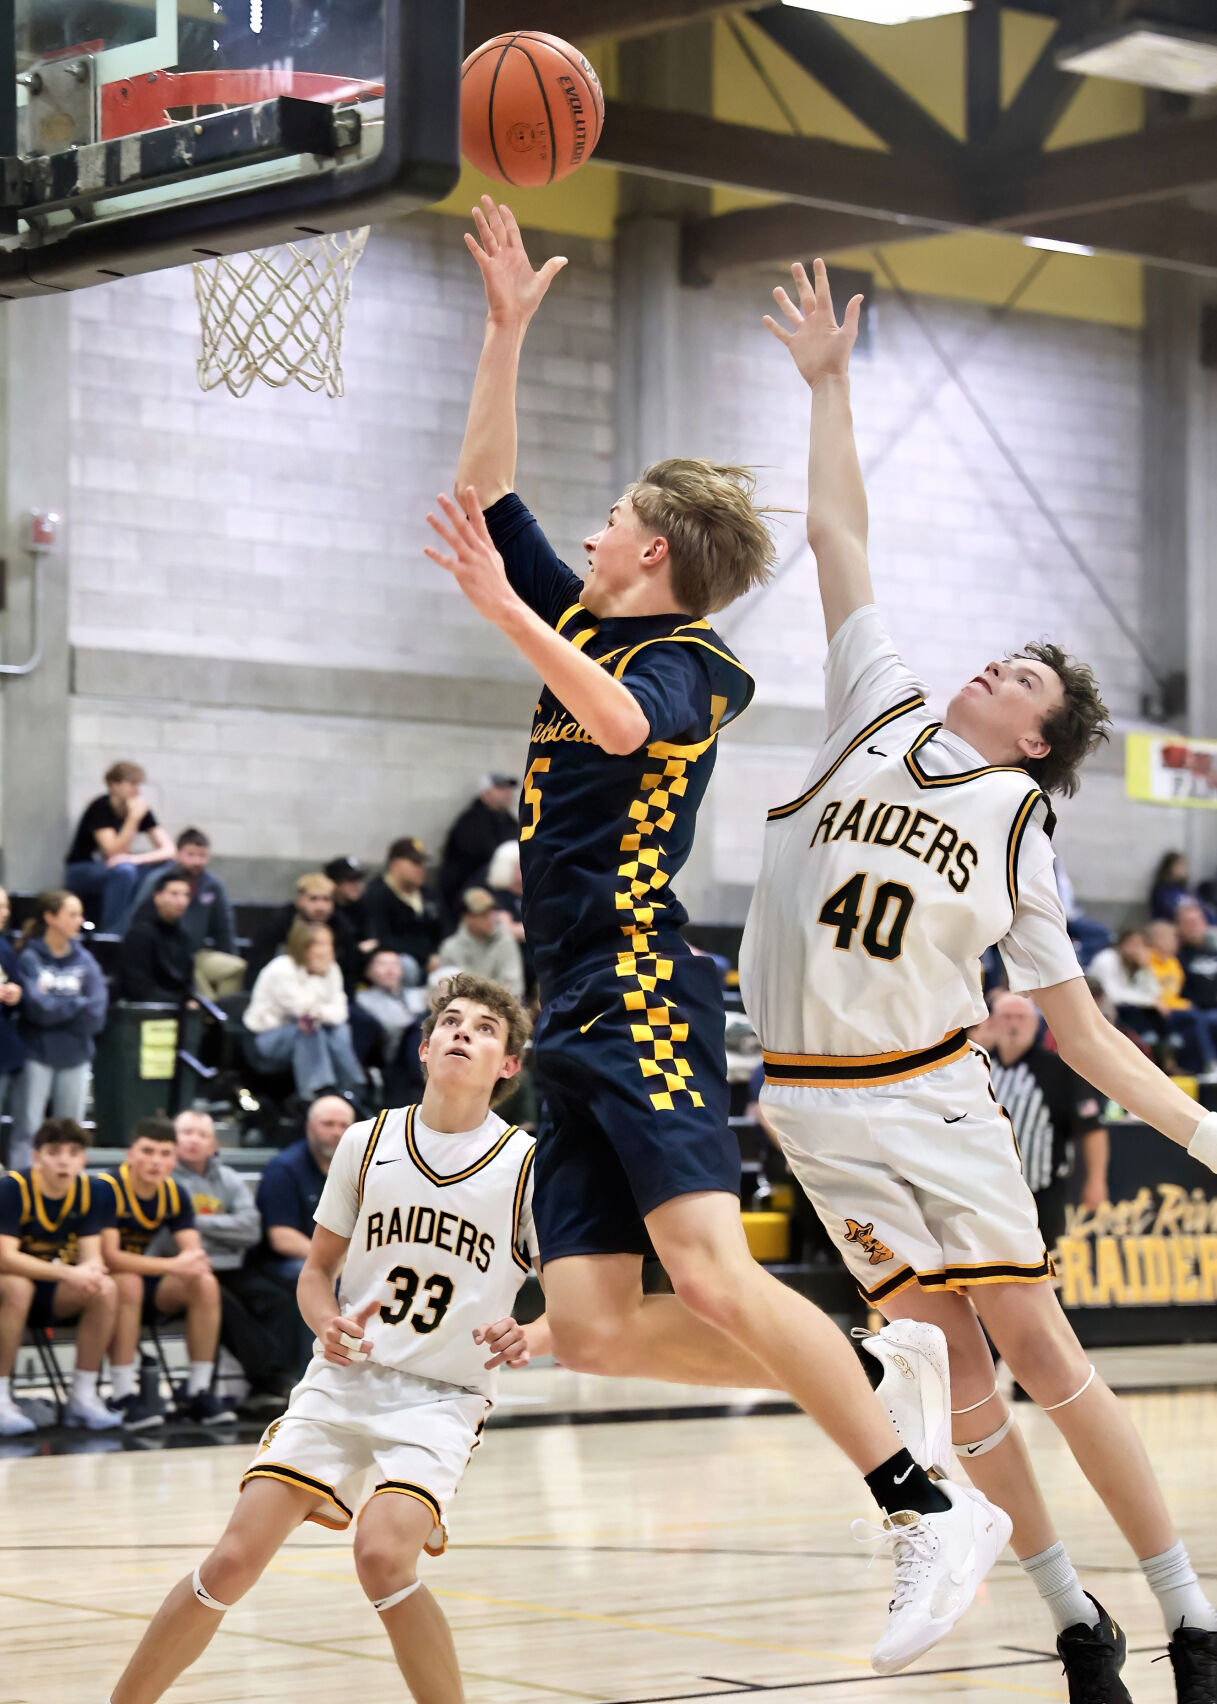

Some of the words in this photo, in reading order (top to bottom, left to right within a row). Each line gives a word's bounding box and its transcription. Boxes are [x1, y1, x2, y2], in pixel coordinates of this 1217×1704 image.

[557, 76, 586, 165] EVOLUTION
[520, 757, 552, 842] 5
[809, 797, 979, 894] RAIDERS
[816, 871, 916, 963] 40
[365, 1205, 496, 1274] RAIDERS
[378, 1264, 456, 1335] 33
